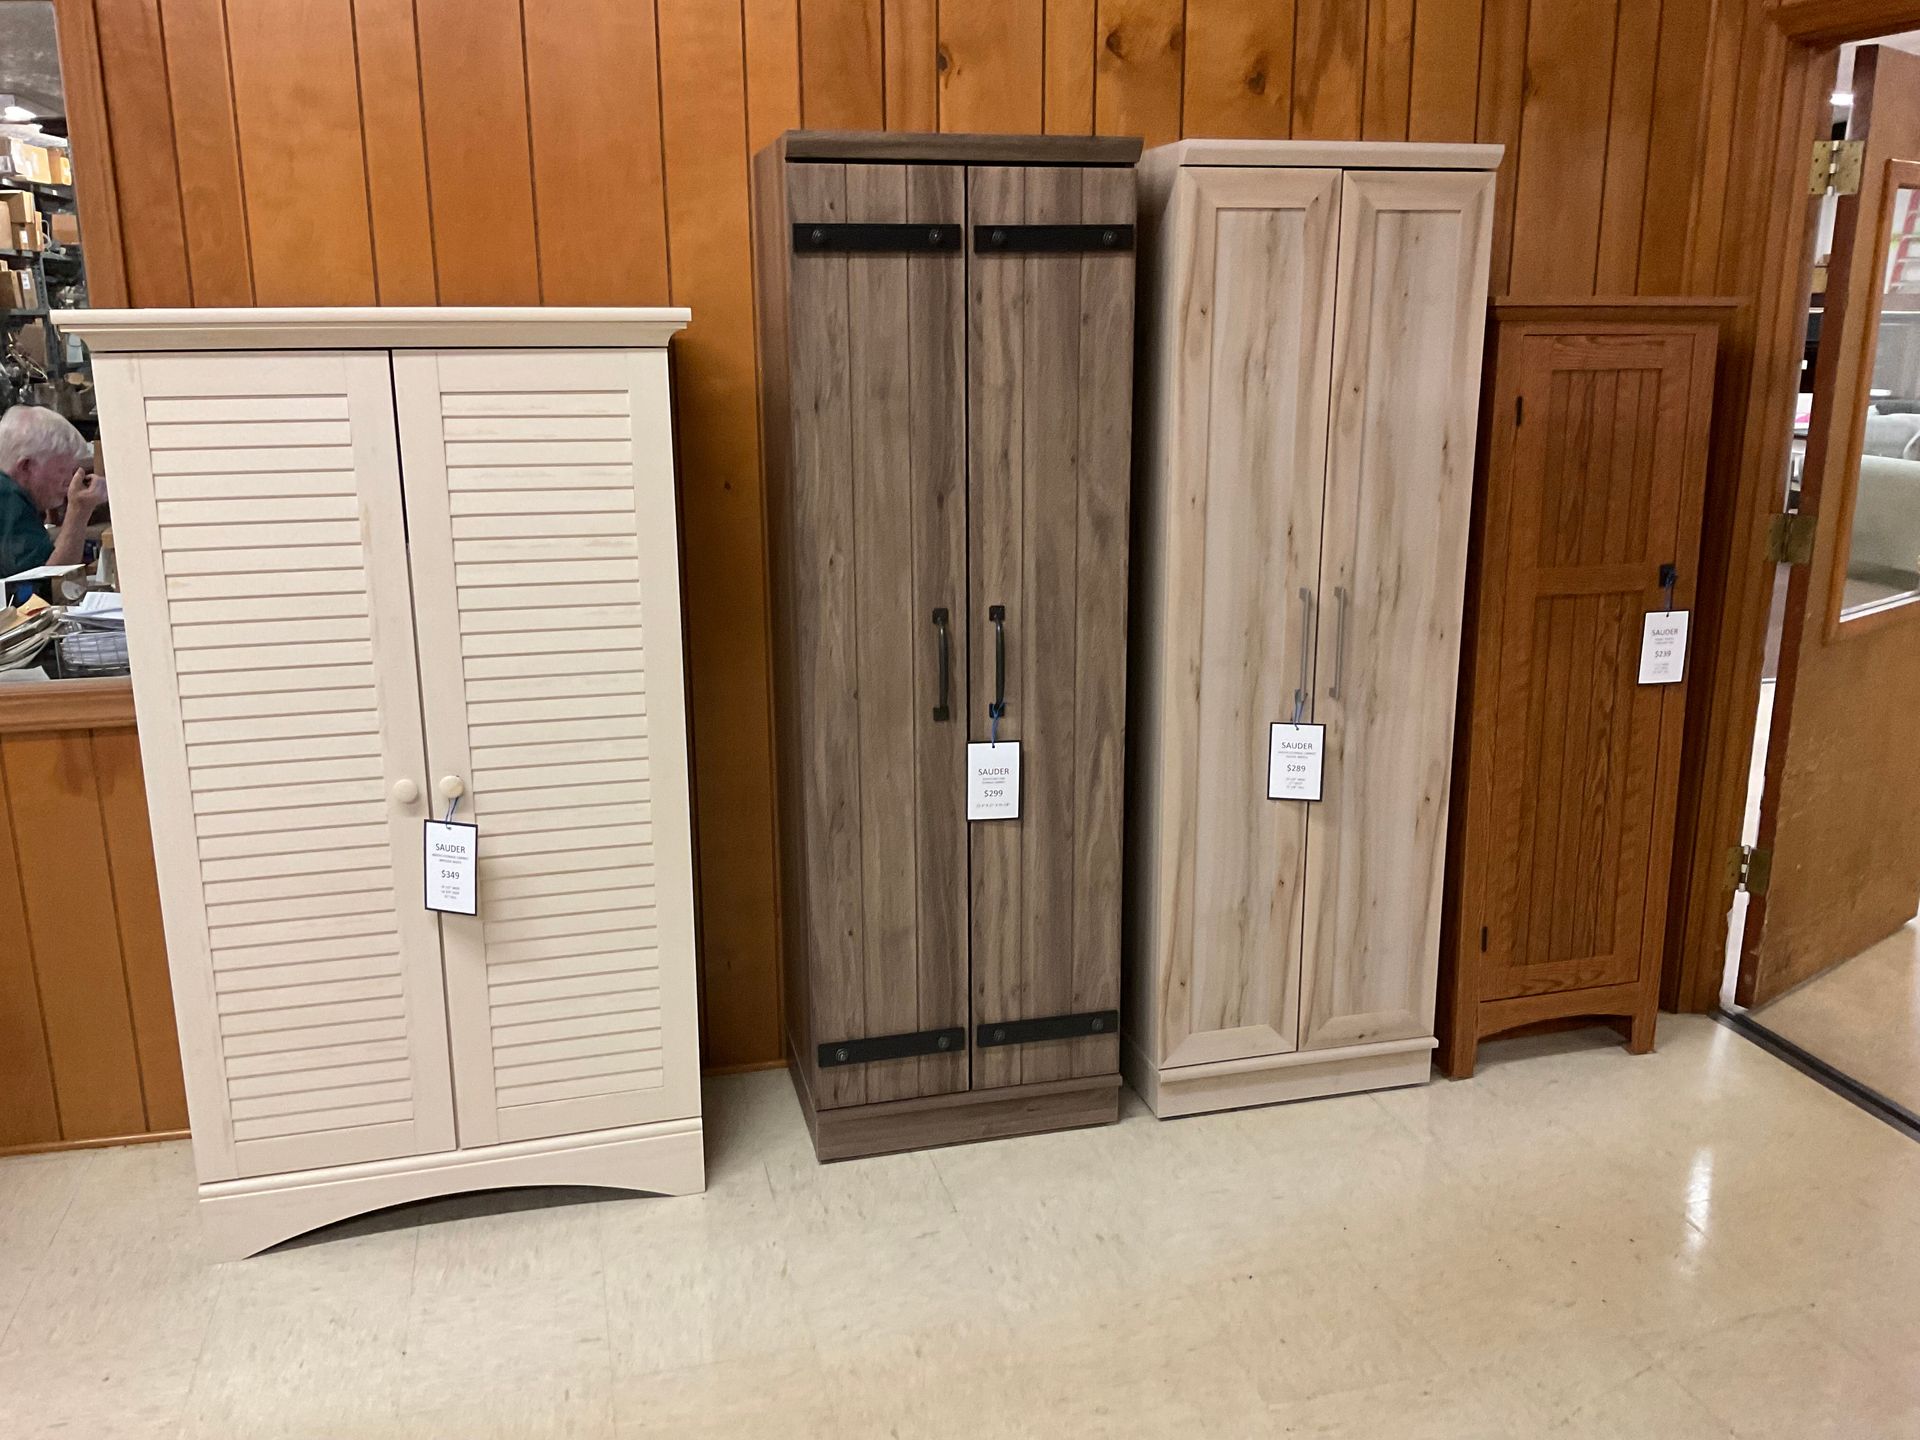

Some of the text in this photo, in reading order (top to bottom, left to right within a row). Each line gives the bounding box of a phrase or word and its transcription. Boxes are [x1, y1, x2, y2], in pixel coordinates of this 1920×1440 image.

[1651, 628, 1679, 637] SAUDER
[1281, 742, 1313, 750] SAUDER
[978, 768, 1010, 776] SAUDER
[1286, 764, 1306, 772] $289
[984, 789, 1004, 798] $299
[435, 843, 466, 854] SAUDER
[441, 869, 460, 880] $349
